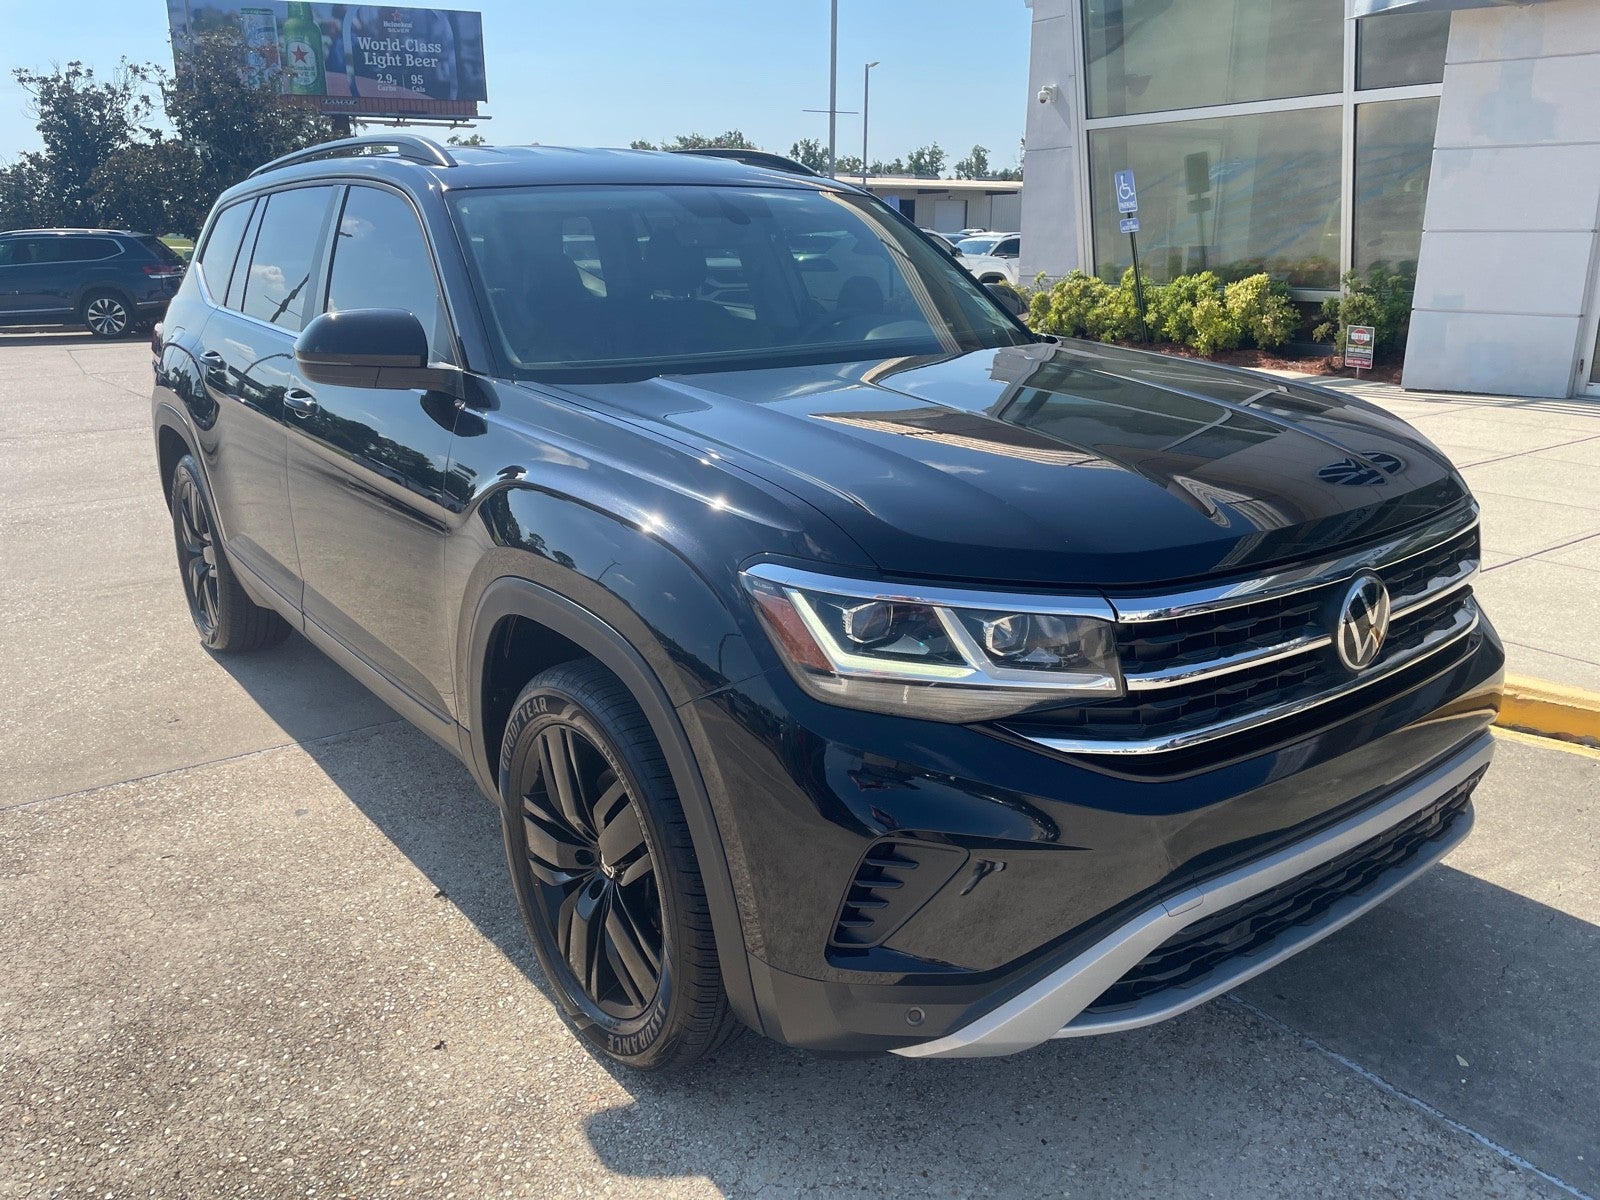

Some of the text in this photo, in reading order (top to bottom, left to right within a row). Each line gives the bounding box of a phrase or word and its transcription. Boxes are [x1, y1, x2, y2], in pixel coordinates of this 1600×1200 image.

[357, 36, 442, 53] World-Class
[363, 52, 438, 69] Light Beer
[410, 74, 424, 85] 95
[502, 697, 548, 771] GOODYEAR
